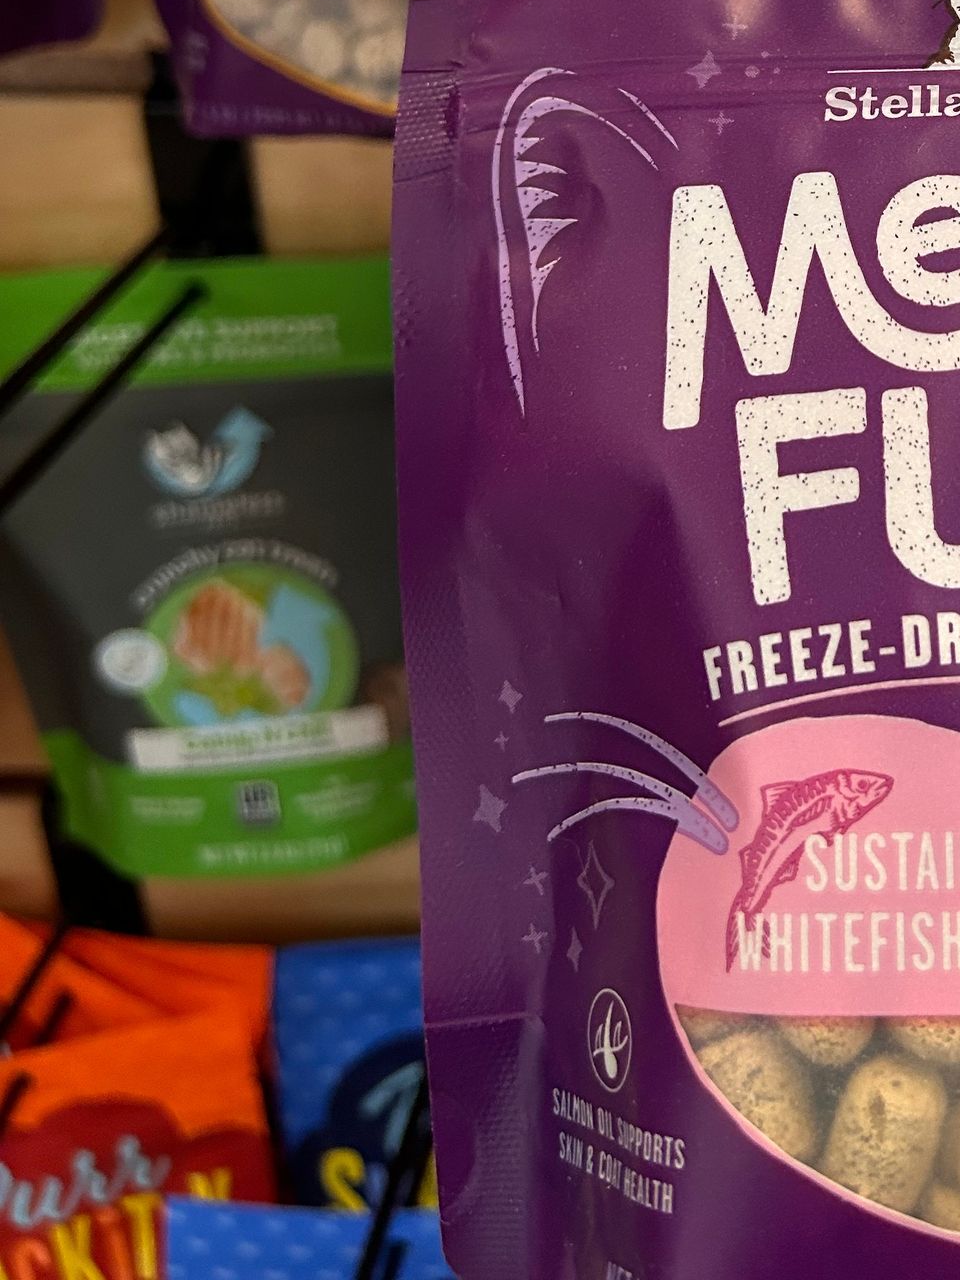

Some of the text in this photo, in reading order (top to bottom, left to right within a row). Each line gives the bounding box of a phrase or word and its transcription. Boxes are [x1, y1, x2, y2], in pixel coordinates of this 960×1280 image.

[553, 1087, 686, 1169] SALMON OIL SUPPORTS
[559, 1131, 674, 1214] SKIN & COAT HEALTH
